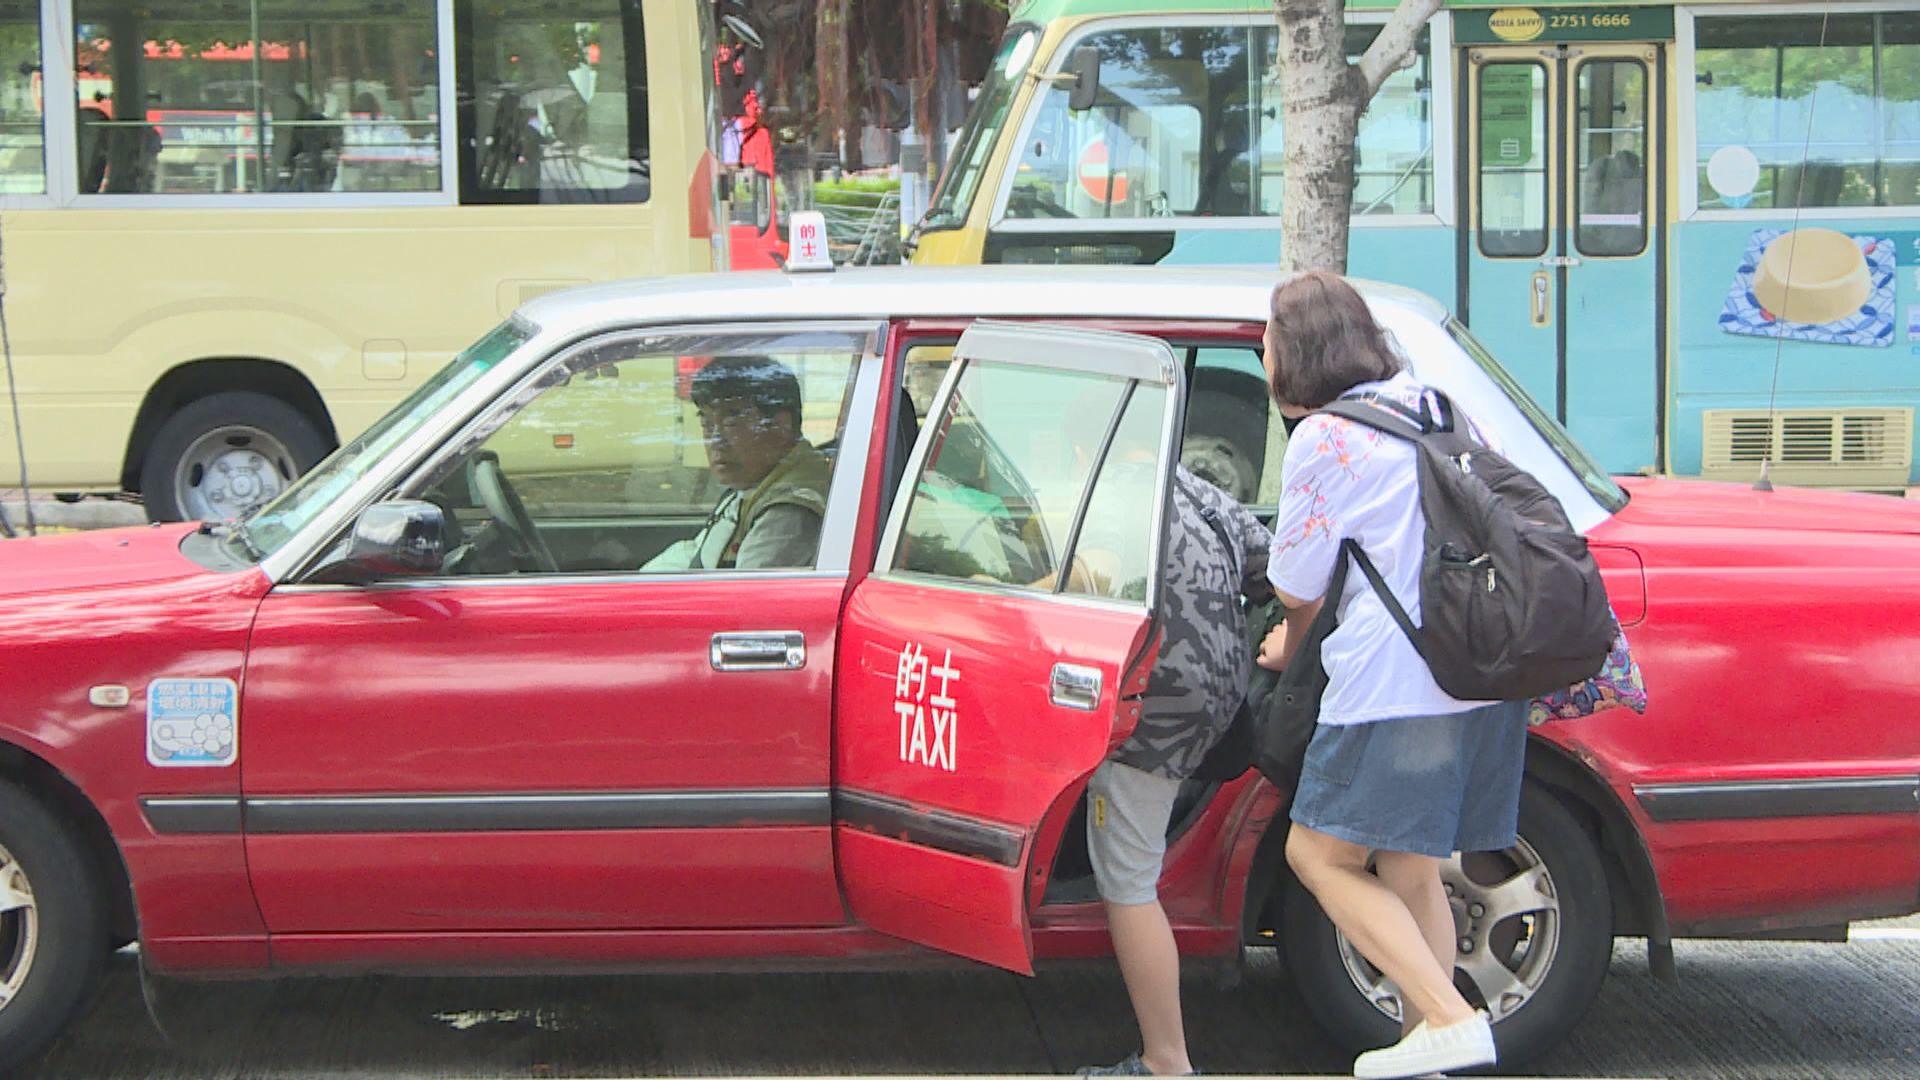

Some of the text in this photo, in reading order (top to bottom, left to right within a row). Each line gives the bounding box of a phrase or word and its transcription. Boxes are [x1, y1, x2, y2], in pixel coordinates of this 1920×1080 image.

[1551, 14, 1631, 27] 2751 6666
[800, 224, 816, 257] 的士
[896, 641, 961, 709] 的士
[894, 700, 957, 772] TAXI
